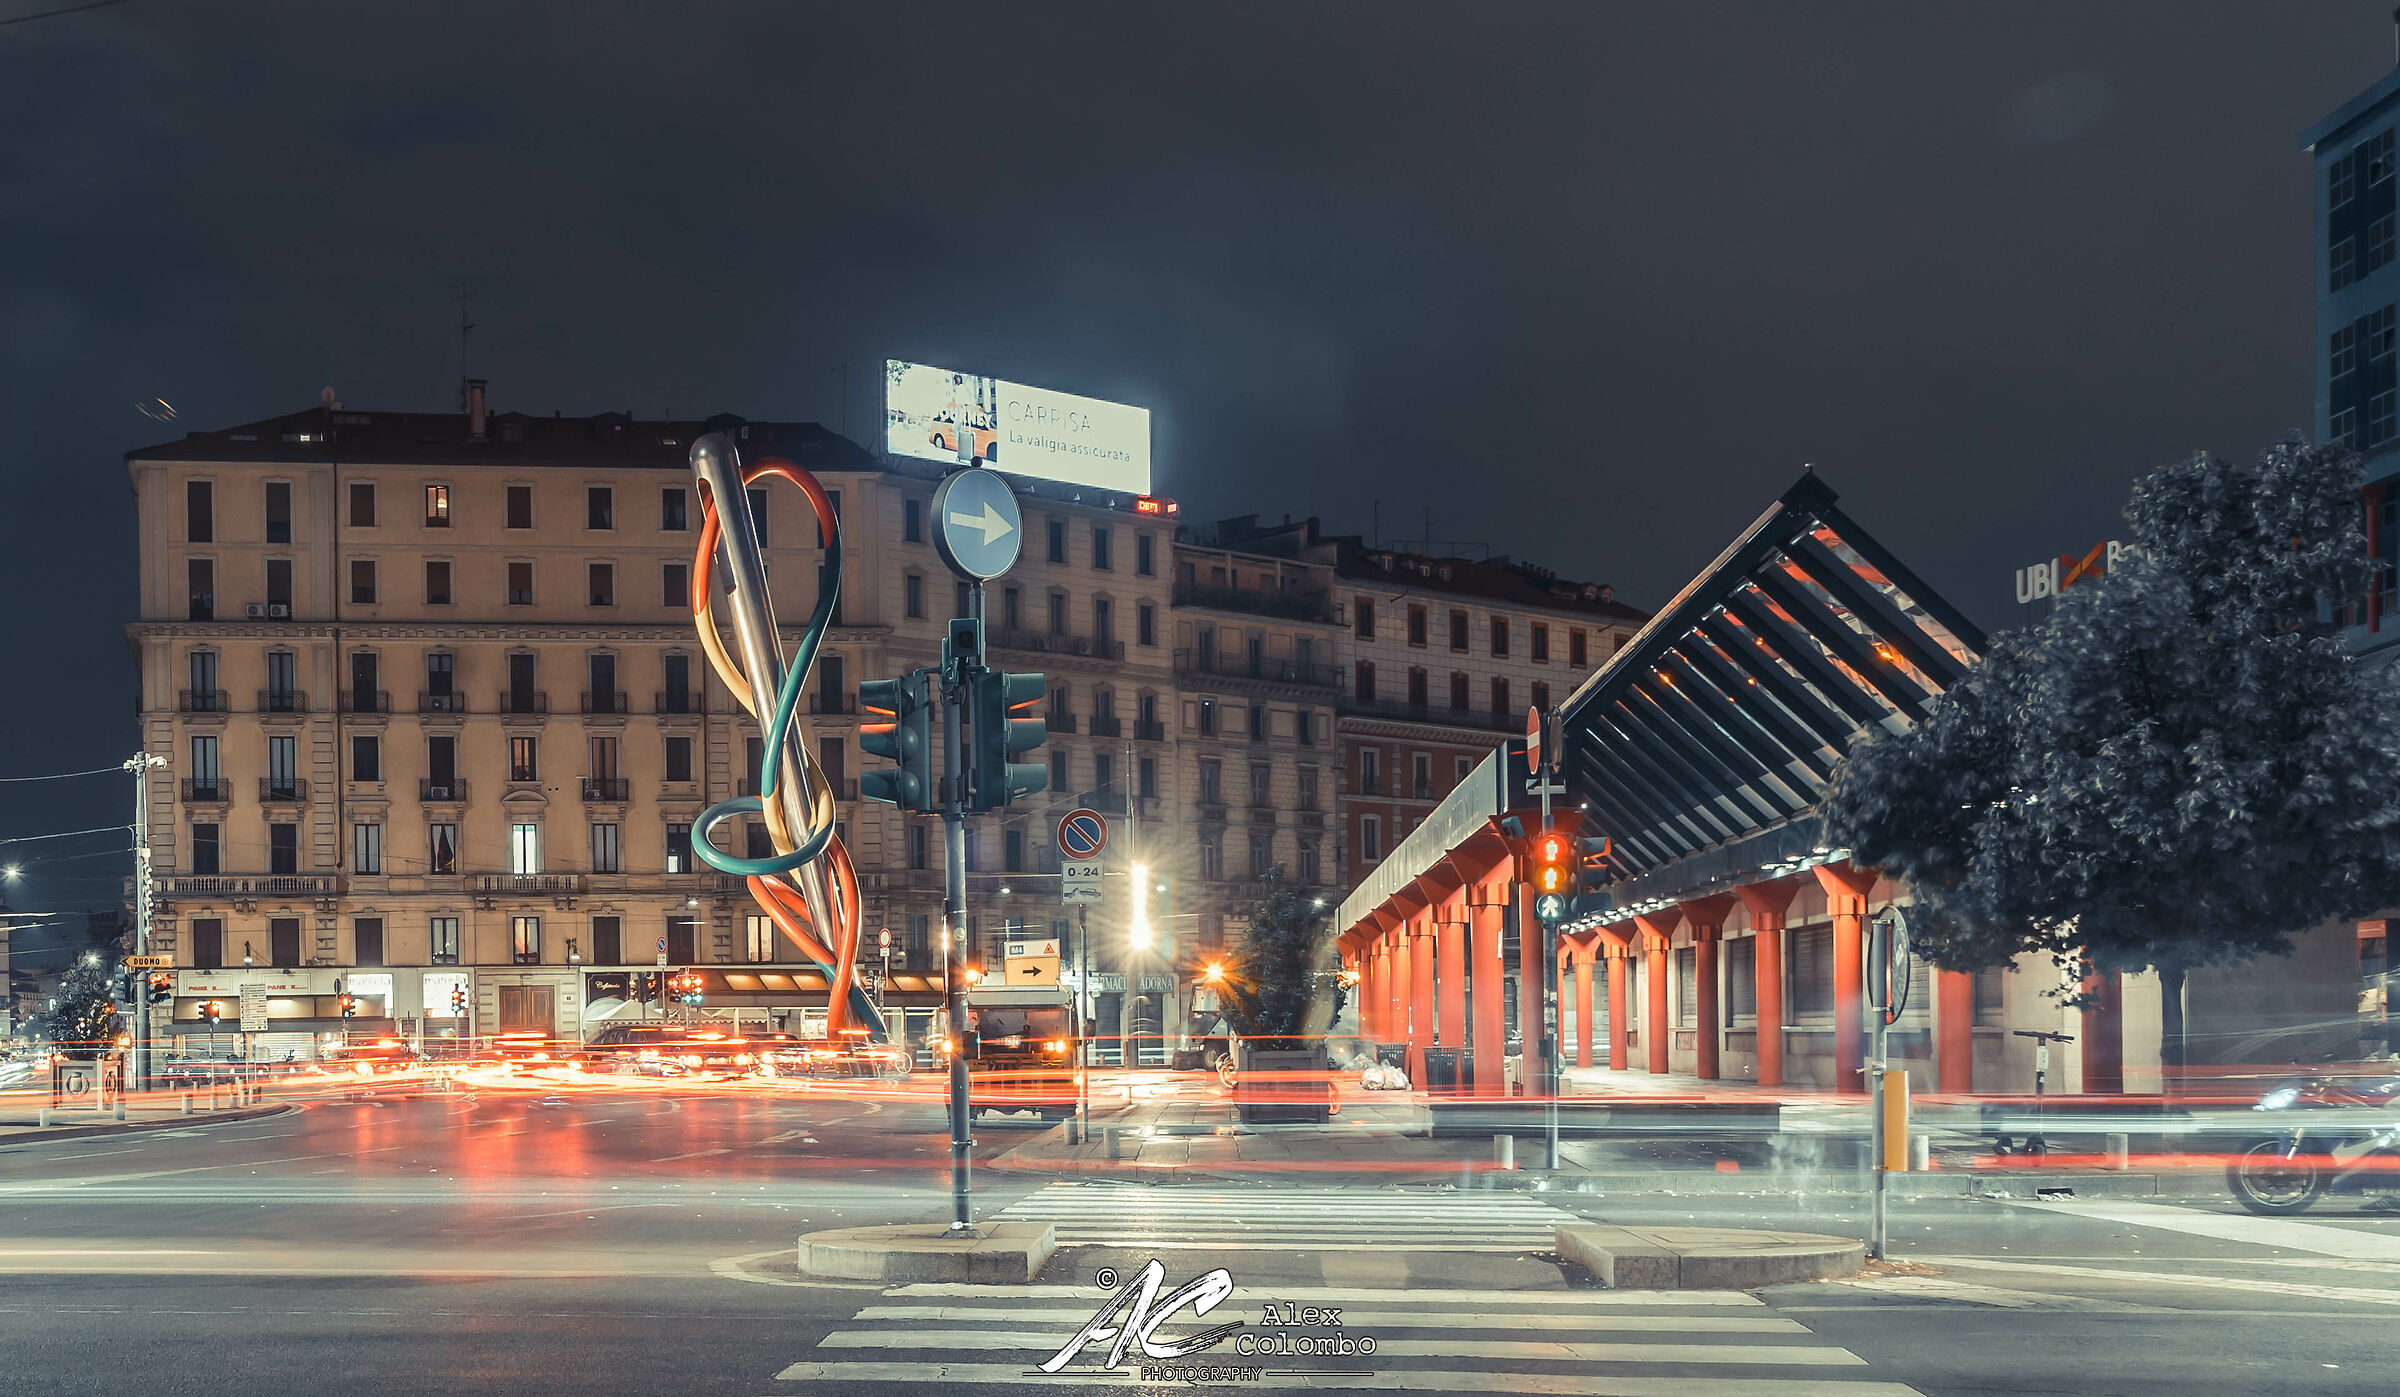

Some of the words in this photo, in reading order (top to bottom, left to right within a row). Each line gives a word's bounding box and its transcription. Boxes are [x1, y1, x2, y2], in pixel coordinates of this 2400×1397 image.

[1008, 400, 1091, 432] CARPISA
[1009, 429, 1024, 444] La
[1027, 435, 1068, 453] valigia
[1070, 444, 1131, 462] assicurata
[2015, 558, 2060, 605] UBI
[1067, 867, 1076, 877] 0
[1083, 867, 1099, 877] 24
[133, 957, 160, 965] DUOMO
[1137, 976, 1173, 990] ADORNA
